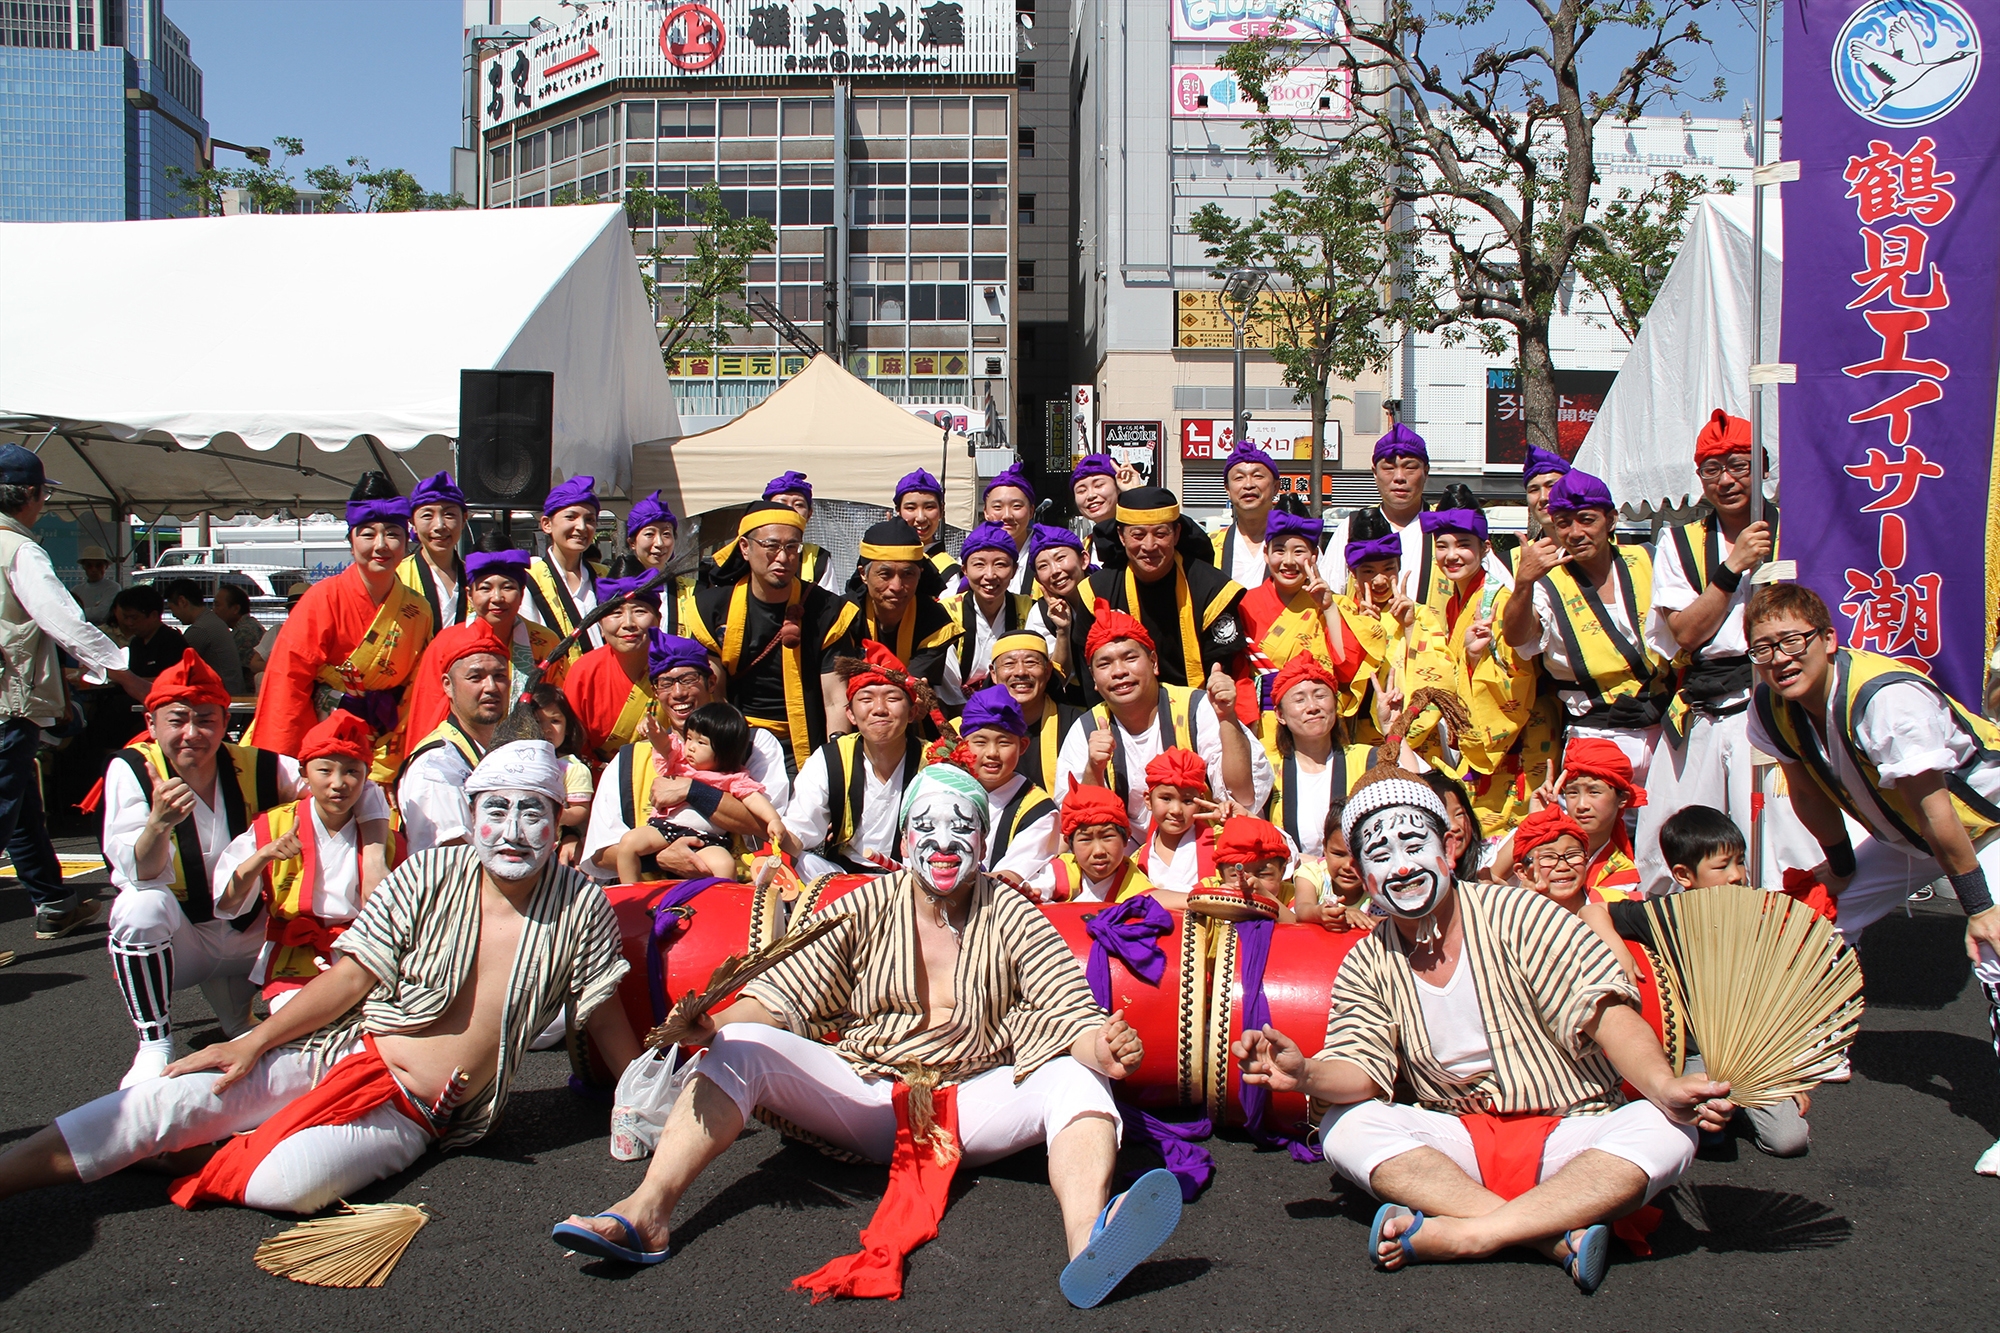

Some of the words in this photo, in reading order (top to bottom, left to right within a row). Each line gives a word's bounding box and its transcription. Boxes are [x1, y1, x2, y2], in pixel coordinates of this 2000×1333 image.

[748, 1, 965, 48] 磯丸水産
[1182, 79, 1200, 92] 受付
[881, 357, 935, 374] 麻雀
[1839, 136, 1956, 676] 鶴見エイサー潮
[1106, 429, 1157, 441] AMORE
[1186, 444, 1210, 457] 入口
